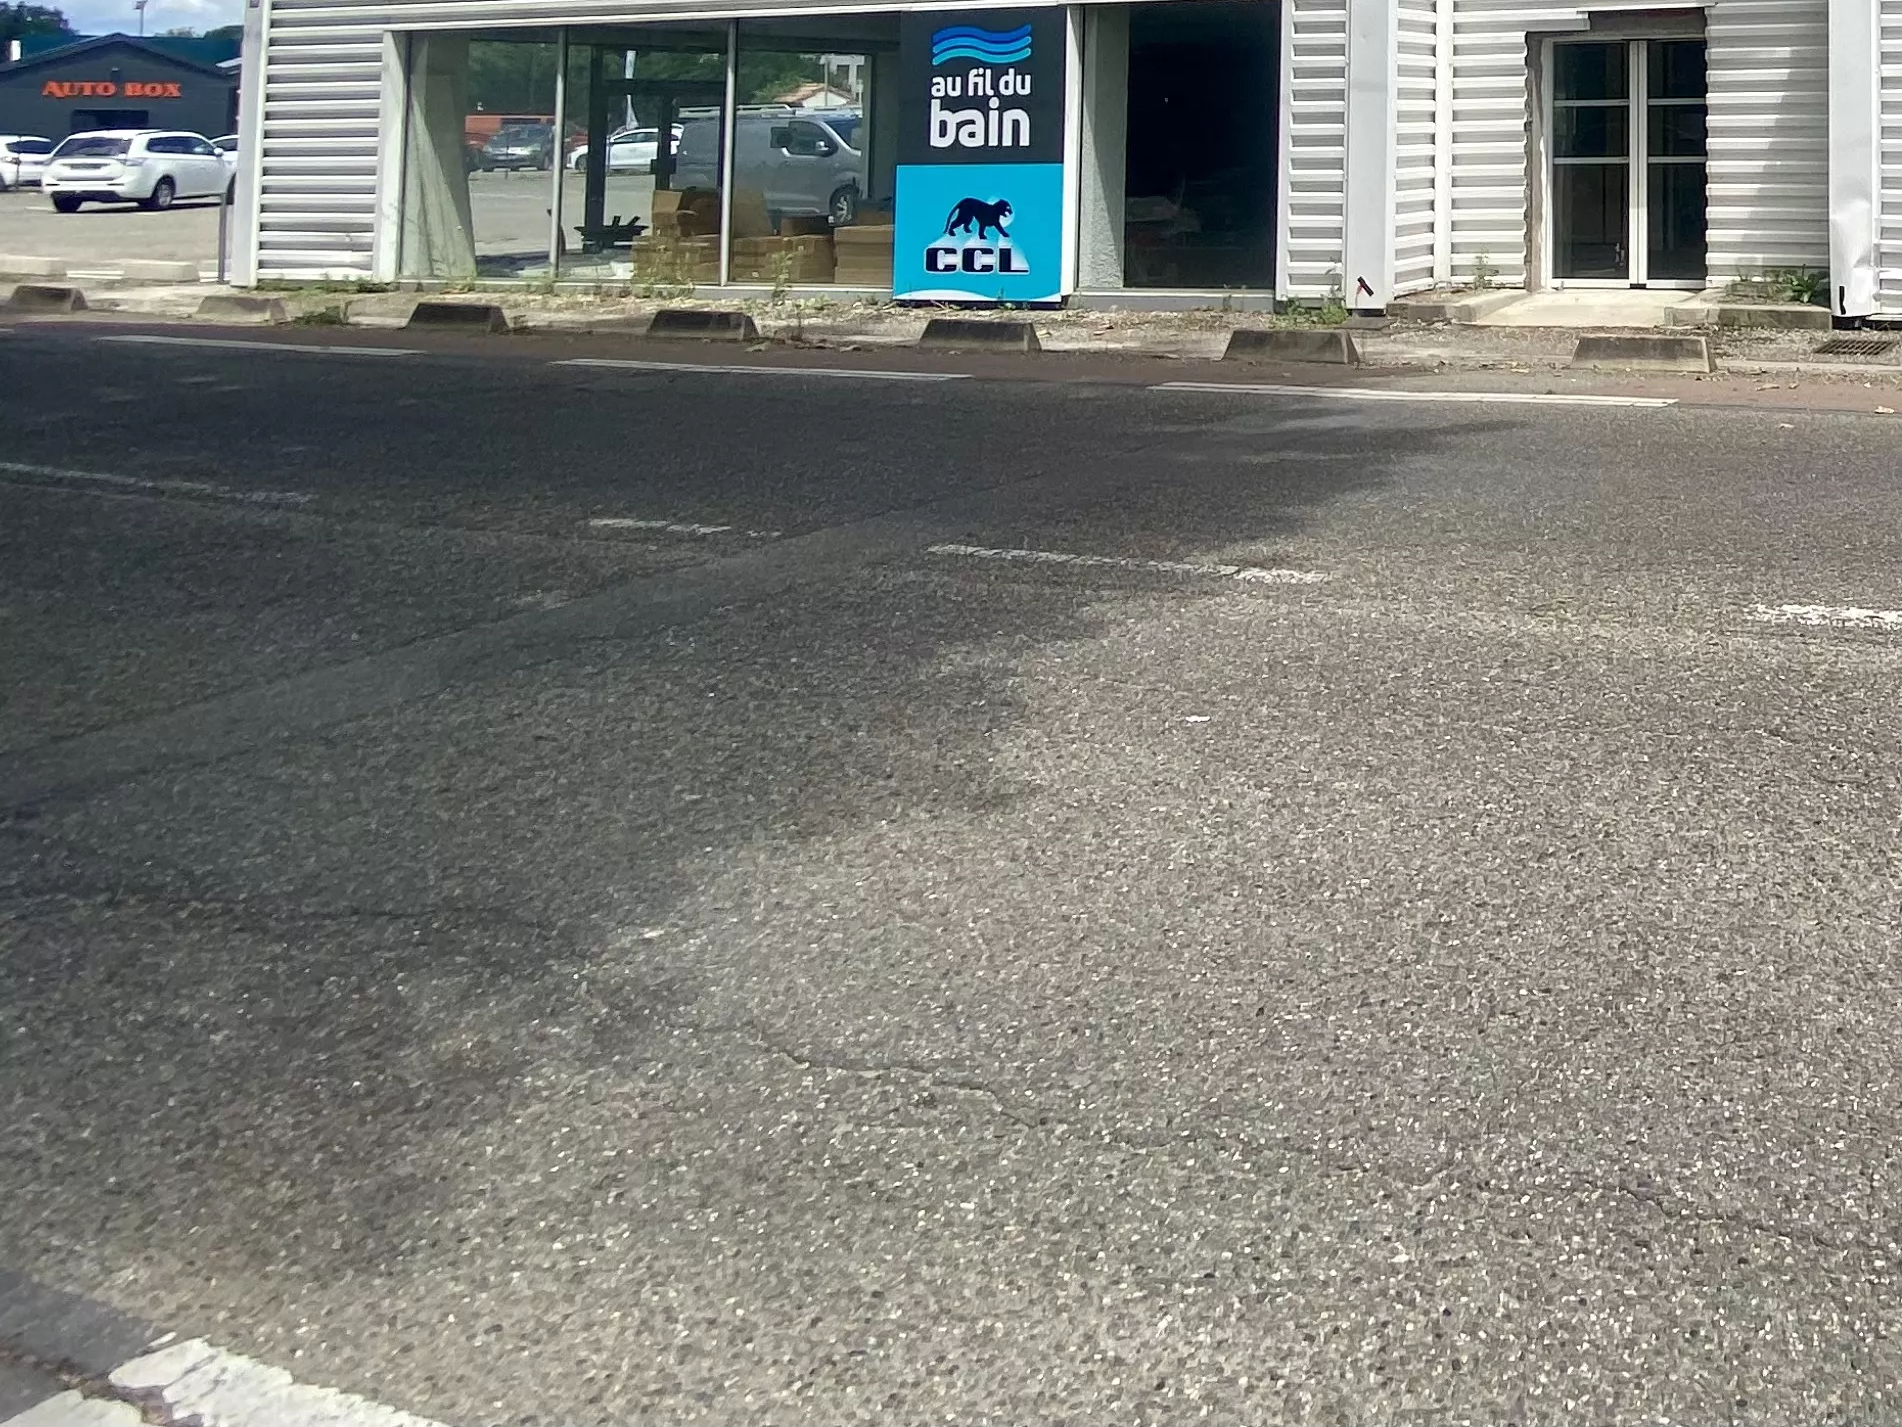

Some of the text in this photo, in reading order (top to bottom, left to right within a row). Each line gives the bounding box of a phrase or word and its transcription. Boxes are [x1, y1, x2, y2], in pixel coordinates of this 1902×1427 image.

[42, 80, 183, 99] AUTO BOX
[931, 67, 1031, 98] au fil du
[929, 96, 1031, 148] bain
[925, 247, 1030, 273] CCL
